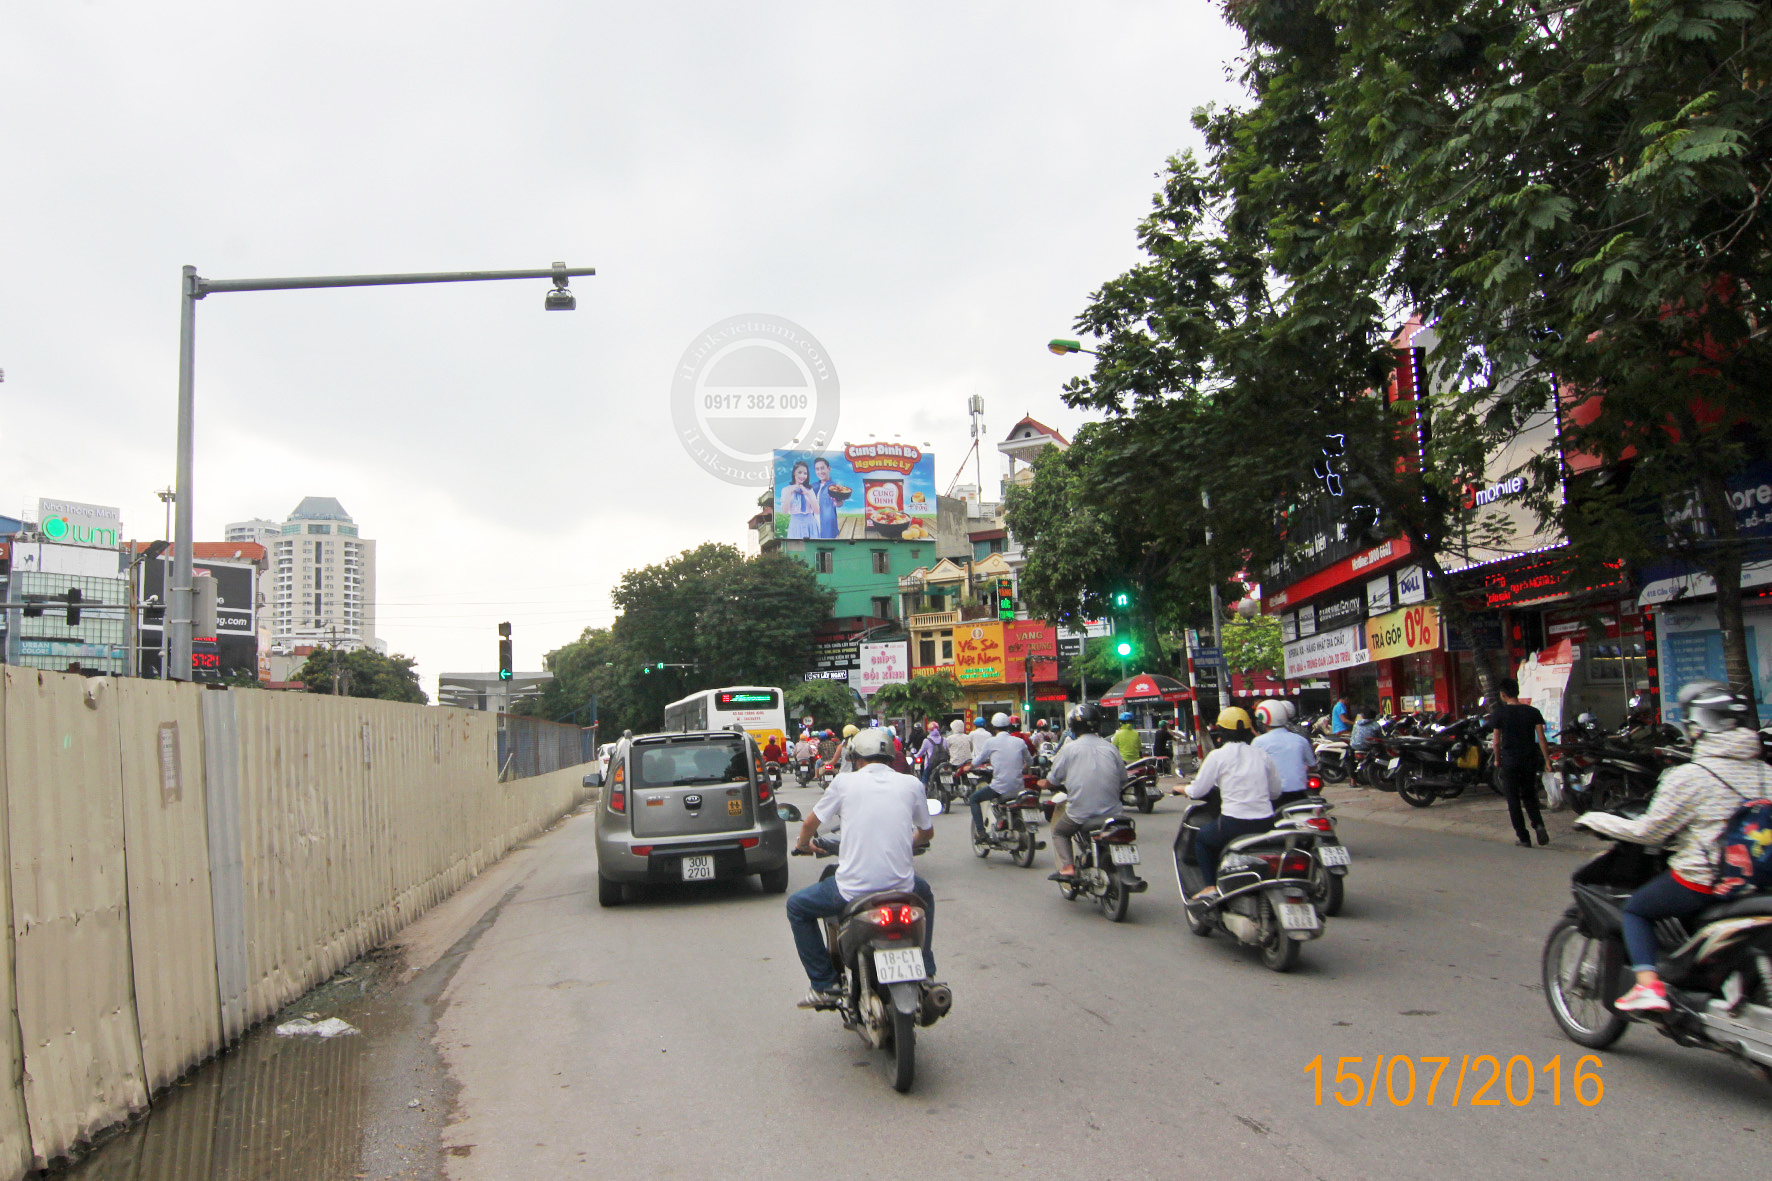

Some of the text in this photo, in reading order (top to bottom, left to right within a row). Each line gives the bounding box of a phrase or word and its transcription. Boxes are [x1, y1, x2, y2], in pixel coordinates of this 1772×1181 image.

[848, 446, 876, 457] Cung
[872, 489, 895, 498] CUNG
[1475, 477, 1524, 506] mobile
[95, 508, 117, 519] Minh
[1400, 575, 1420, 595] DELL
[1385, 624, 1402, 646] GÓP
[1404, 606, 1431, 648] 0%
[977, 652, 1002, 665] Nam
[1355, 651, 1367, 663] SONY
[912, 667, 935, 677] PHOTO
[688, 857, 708, 868] 30U
[687, 867, 710, 878] 2701
[882, 950, 915, 966] 18-C1
[880, 964, 922, 980] 074.16
